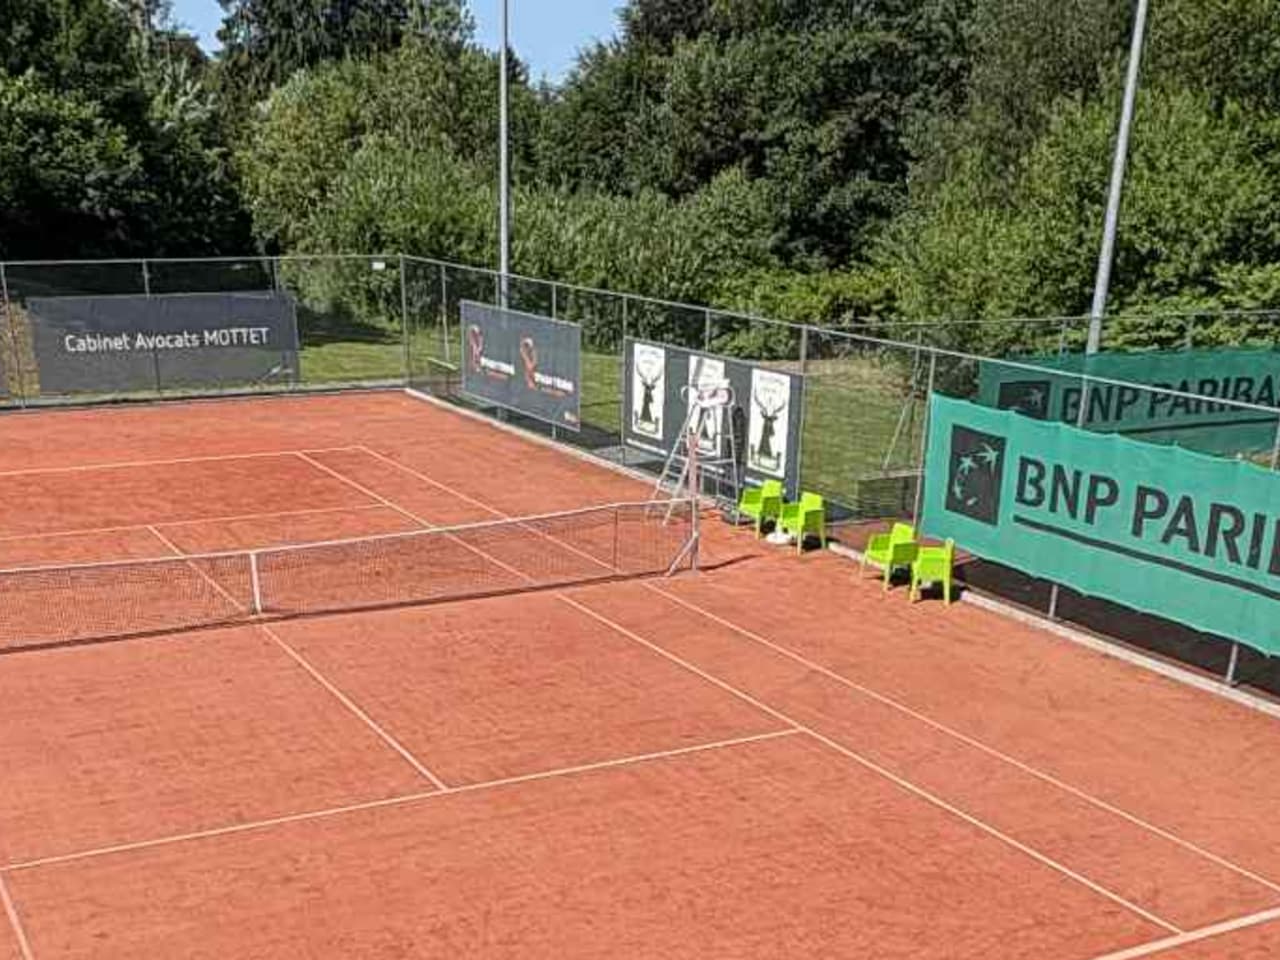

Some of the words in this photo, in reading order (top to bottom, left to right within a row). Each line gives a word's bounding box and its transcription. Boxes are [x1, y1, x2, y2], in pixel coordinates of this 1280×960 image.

[65, 332, 131, 351] Cabinet
[134, 330, 200, 349] Avocats
[203, 327, 270, 346] MOTTET
[1062, 383, 1146, 425] BNP
[1015, 455, 1120, 526] BNP
